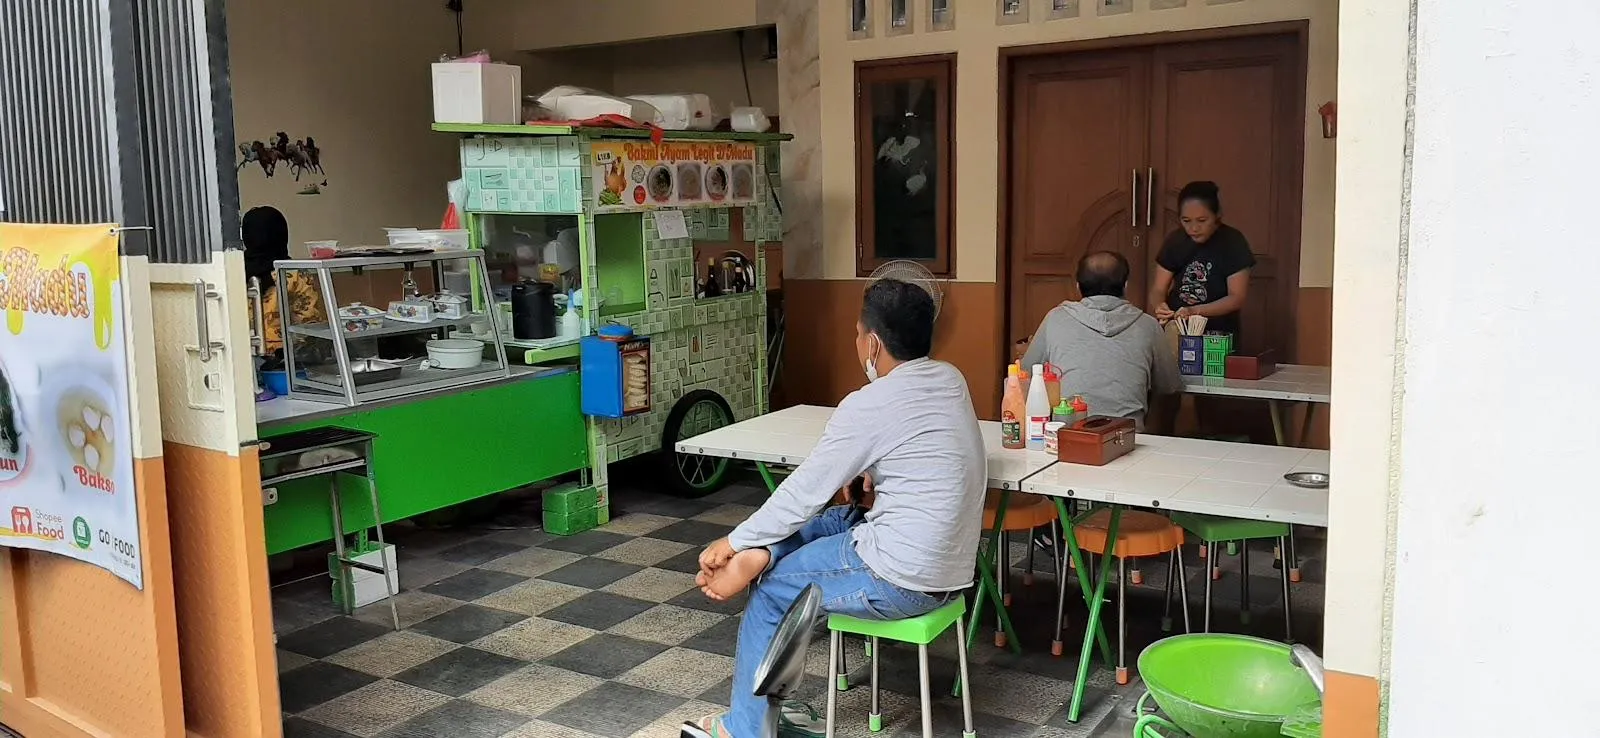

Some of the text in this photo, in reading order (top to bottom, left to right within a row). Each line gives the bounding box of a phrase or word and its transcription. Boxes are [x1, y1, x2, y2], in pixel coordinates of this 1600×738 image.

[660, 143, 690, 164] Ayam
[35, 508, 63, 524] Shopee
[37, 521, 65, 540] Food
